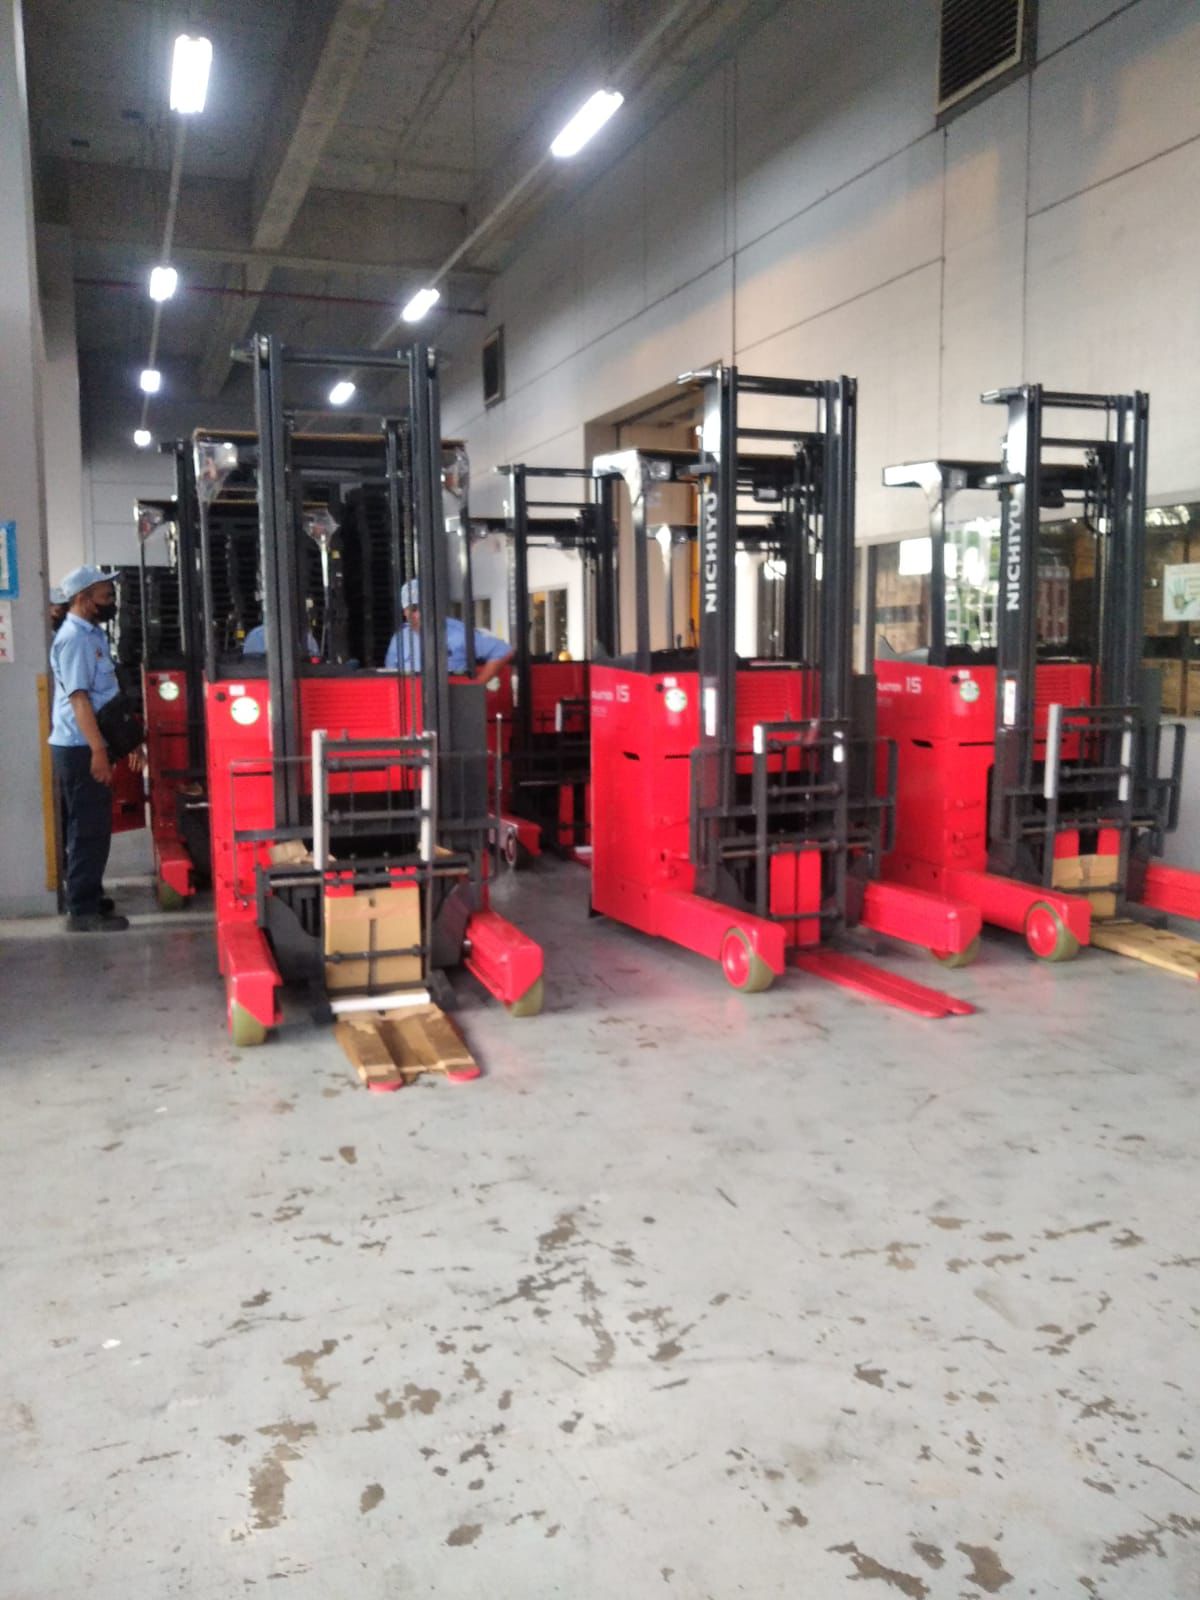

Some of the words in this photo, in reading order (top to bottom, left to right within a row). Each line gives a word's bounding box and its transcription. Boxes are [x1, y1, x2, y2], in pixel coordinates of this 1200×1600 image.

[704, 491, 718, 614] NICHIYU
[1006, 500, 1021, 612] NICHIYU
[905, 676, 922, 694] 15
